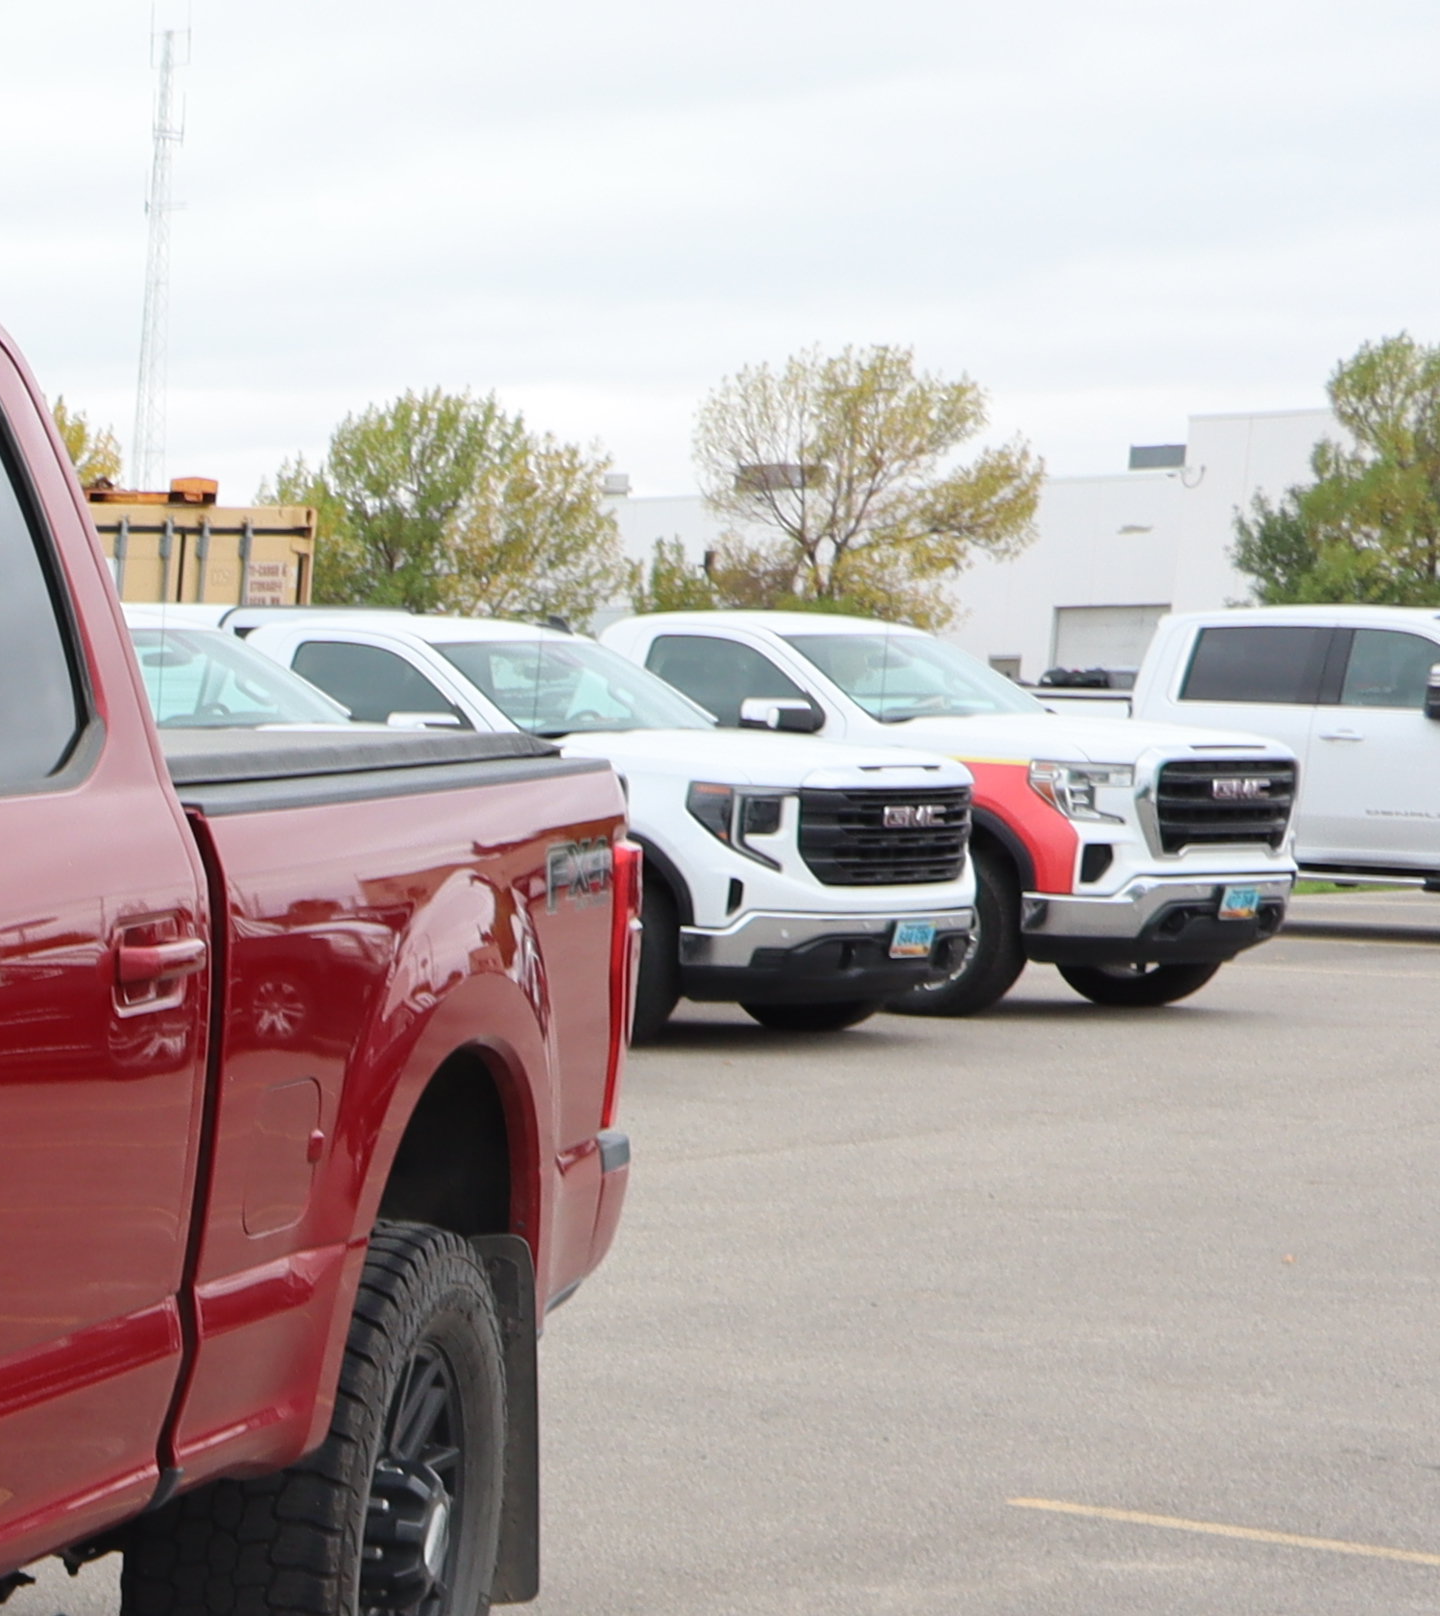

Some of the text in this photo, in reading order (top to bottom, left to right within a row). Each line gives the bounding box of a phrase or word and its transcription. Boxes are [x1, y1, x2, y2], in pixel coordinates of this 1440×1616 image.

[1213, 778, 1271, 800] GMC
[884, 805, 947, 828] GMC
[545, 835, 612, 915] FX4
